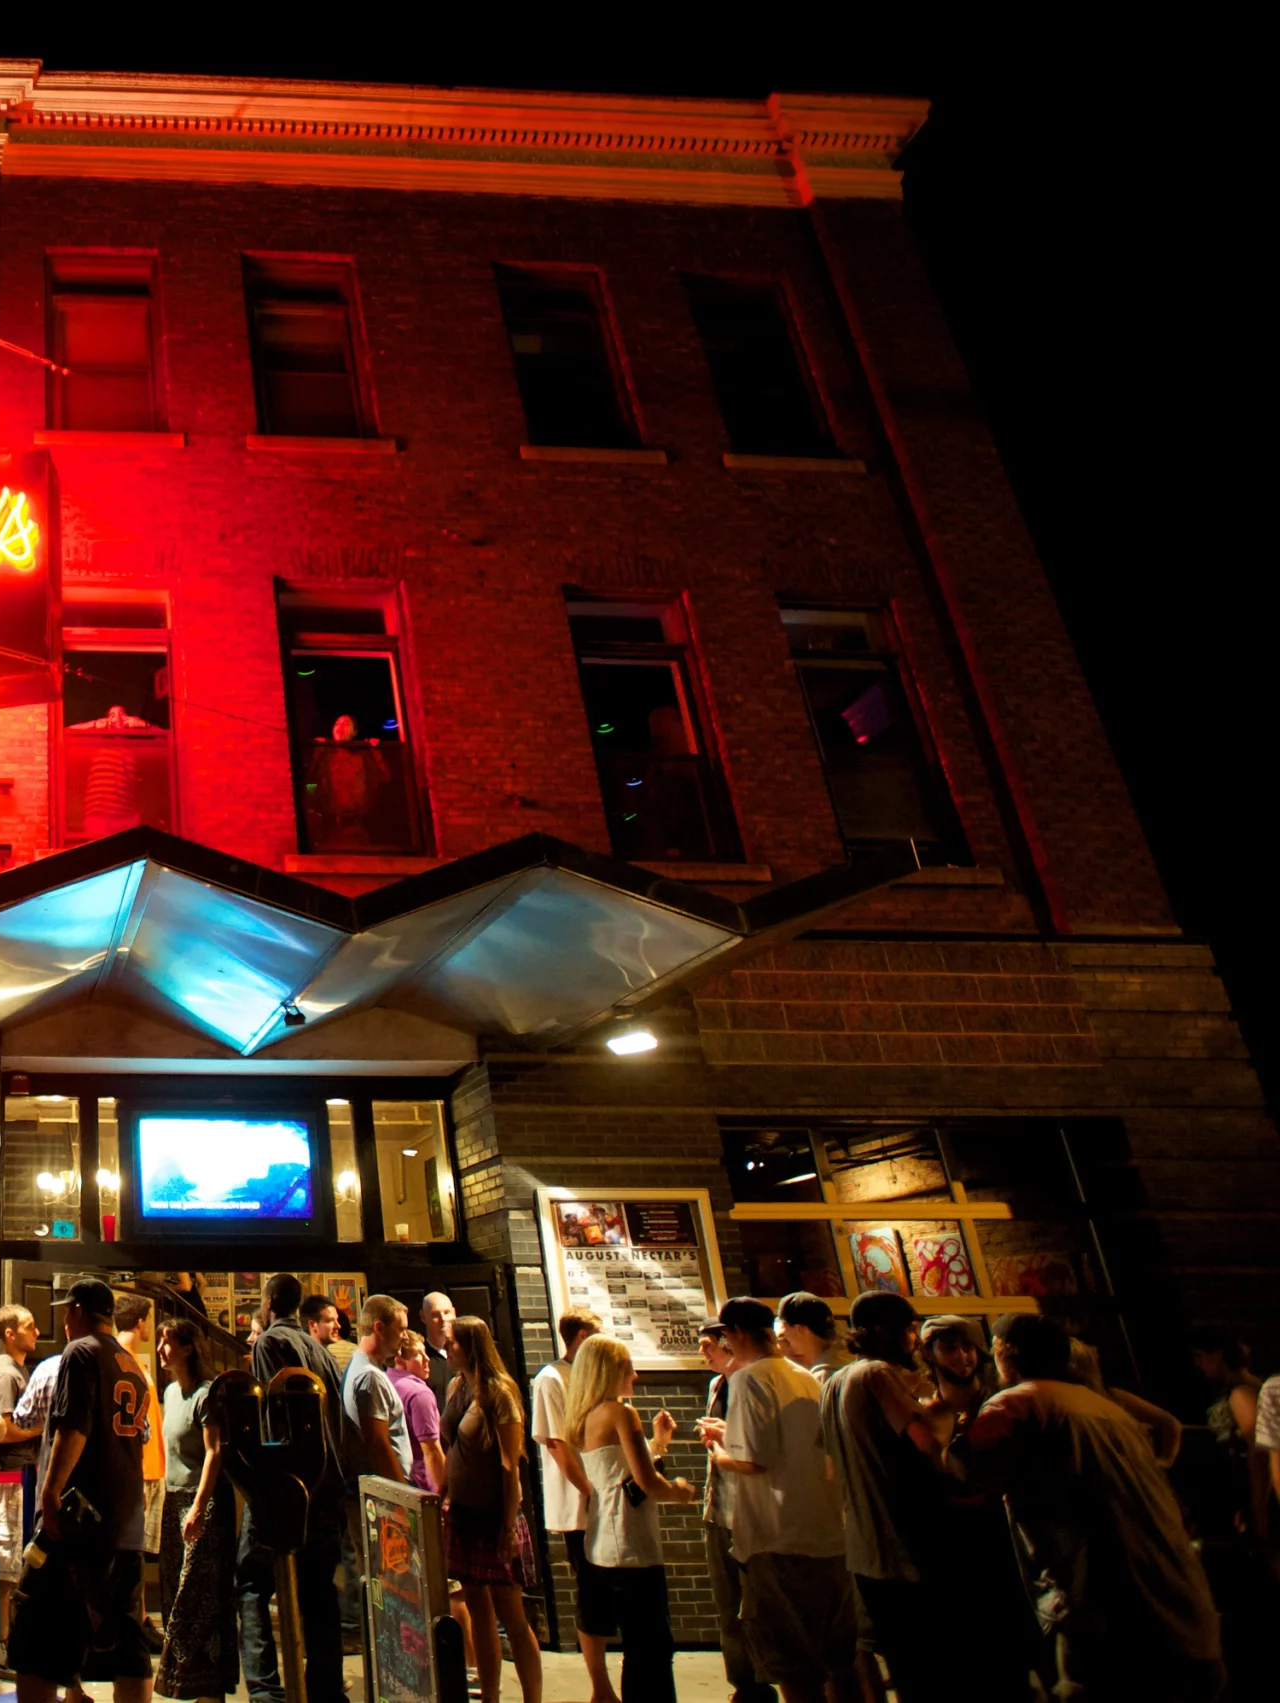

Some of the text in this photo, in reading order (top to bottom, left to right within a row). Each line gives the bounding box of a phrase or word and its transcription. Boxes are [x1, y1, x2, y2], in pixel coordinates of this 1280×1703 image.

[566, 1250, 620, 1261] AUGUST
[631, 1250, 697, 1261] NECTAR'S
[671, 1329, 691, 1337] FOR
